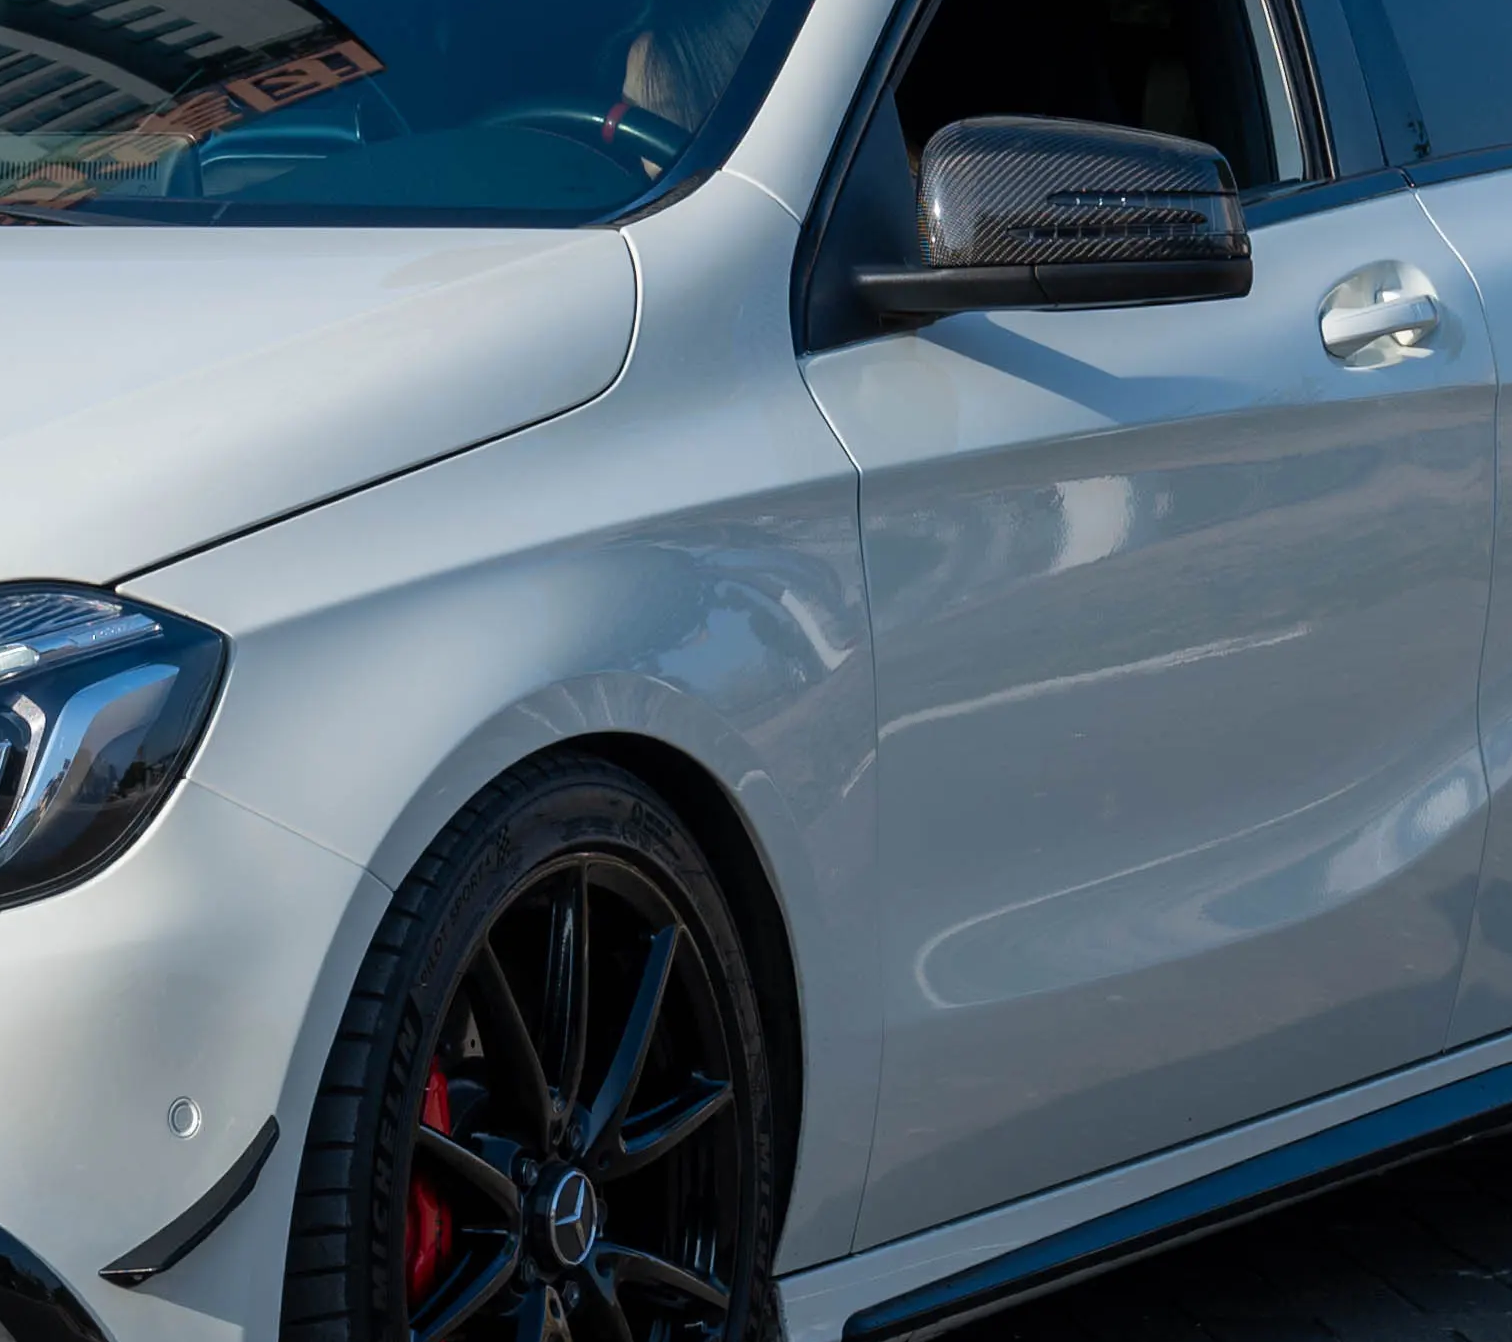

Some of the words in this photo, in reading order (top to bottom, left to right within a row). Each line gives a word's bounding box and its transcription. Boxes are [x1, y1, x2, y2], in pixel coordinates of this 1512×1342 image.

[419, 922, 450, 984] PILOT
[449, 860, 484, 927] SPORT
[371, 1014, 418, 1312] MICHELIN
